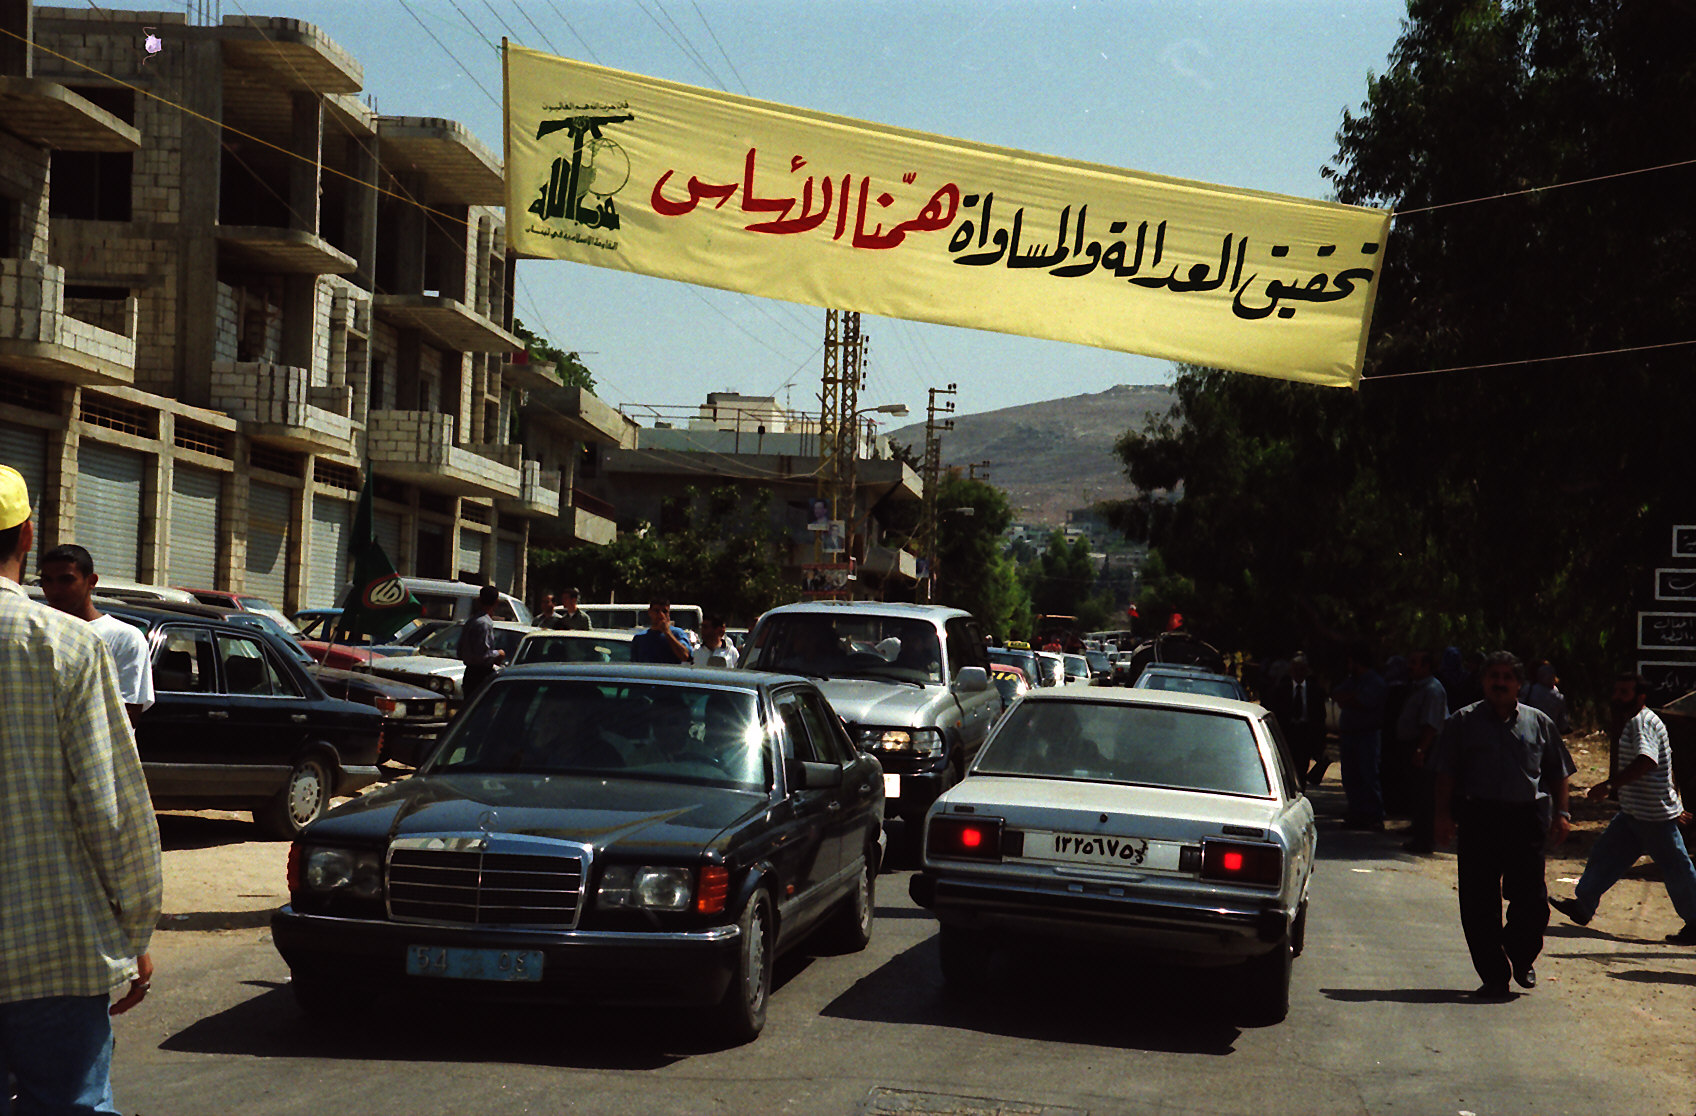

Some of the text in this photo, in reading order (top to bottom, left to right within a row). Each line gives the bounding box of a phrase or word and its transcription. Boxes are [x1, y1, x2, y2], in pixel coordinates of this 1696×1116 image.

[650, 147, 852, 241] الأساس
[949, 192, 1103, 278] والمساواة
[1101, 220, 1248, 293] العدالة
[1232, 242, 1379, 320] تحقيق
